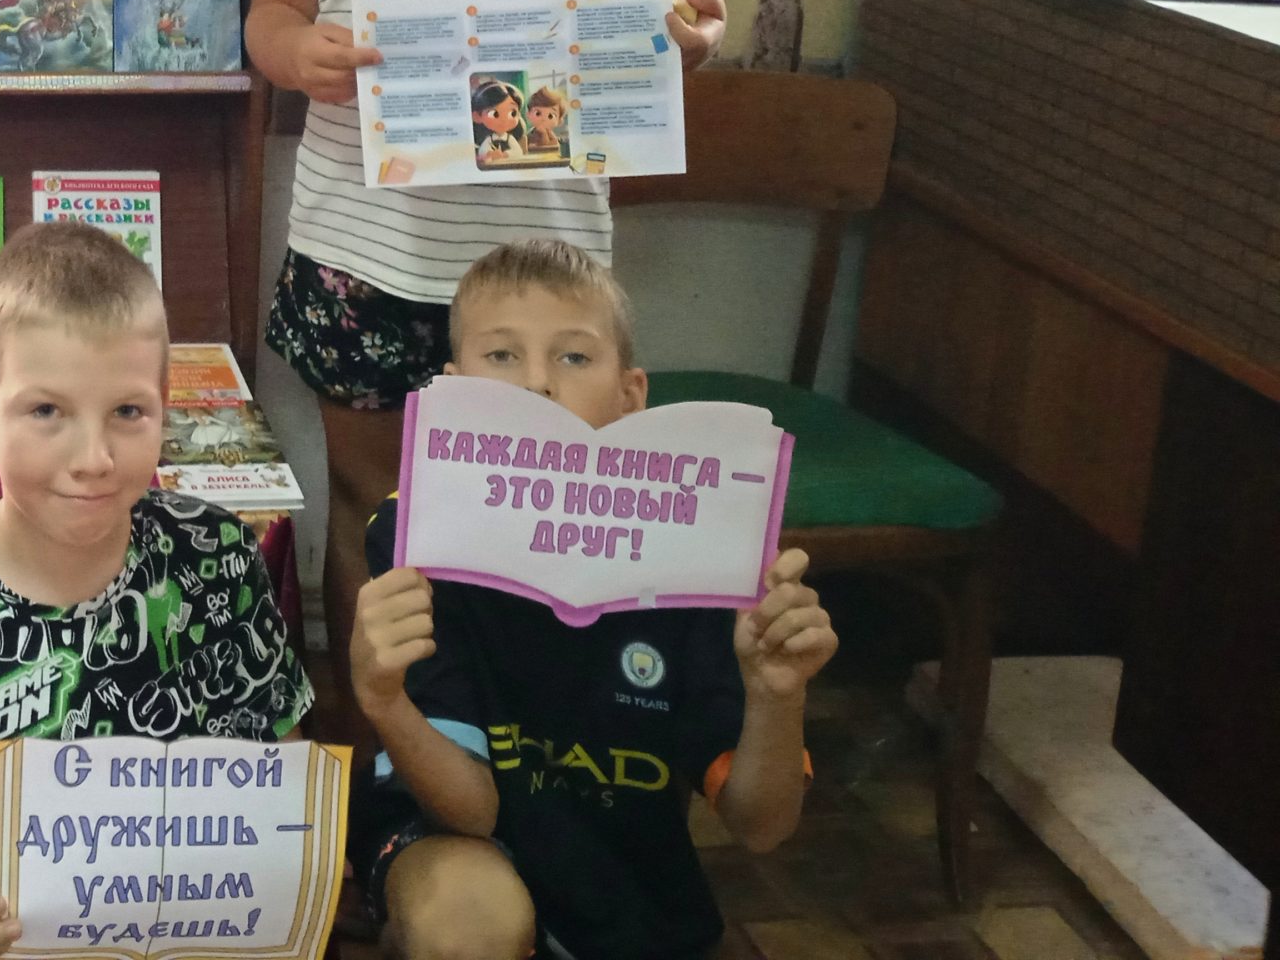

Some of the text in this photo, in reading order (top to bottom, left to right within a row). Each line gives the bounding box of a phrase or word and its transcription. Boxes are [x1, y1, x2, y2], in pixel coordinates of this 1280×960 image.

[428, 428, 588, 474] КАЖДАЯ
[596, 447, 721, 488] КНИГА
[484, 475, 699, 525] ЭТО НОВЫЙ
[529, 520, 644, 562] ДРУГ!
